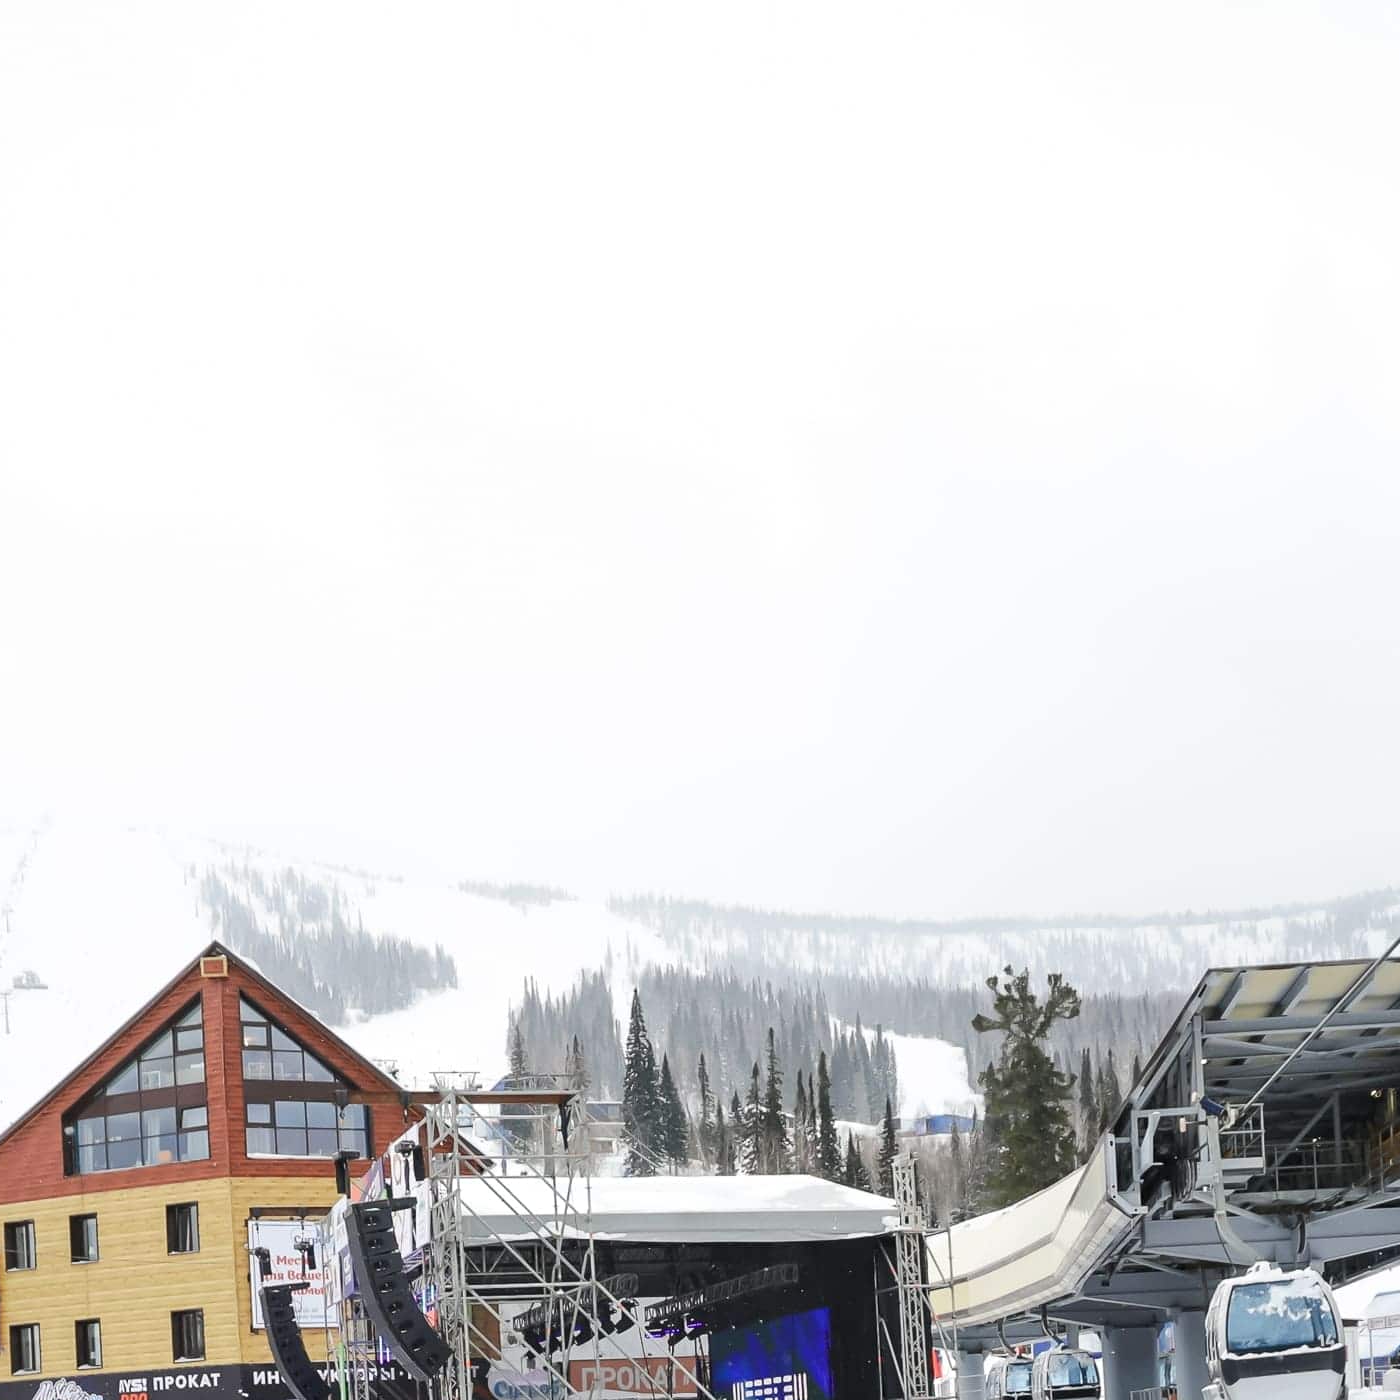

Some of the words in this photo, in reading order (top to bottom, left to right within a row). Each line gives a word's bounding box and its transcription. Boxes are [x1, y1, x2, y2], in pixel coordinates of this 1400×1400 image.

[153, 1373, 221, 1391] ПРОКАТ
[253, 1367, 396, 1385] ИНУКТОРЫ
[581, 1364, 677, 1392] ПРОКАТ
